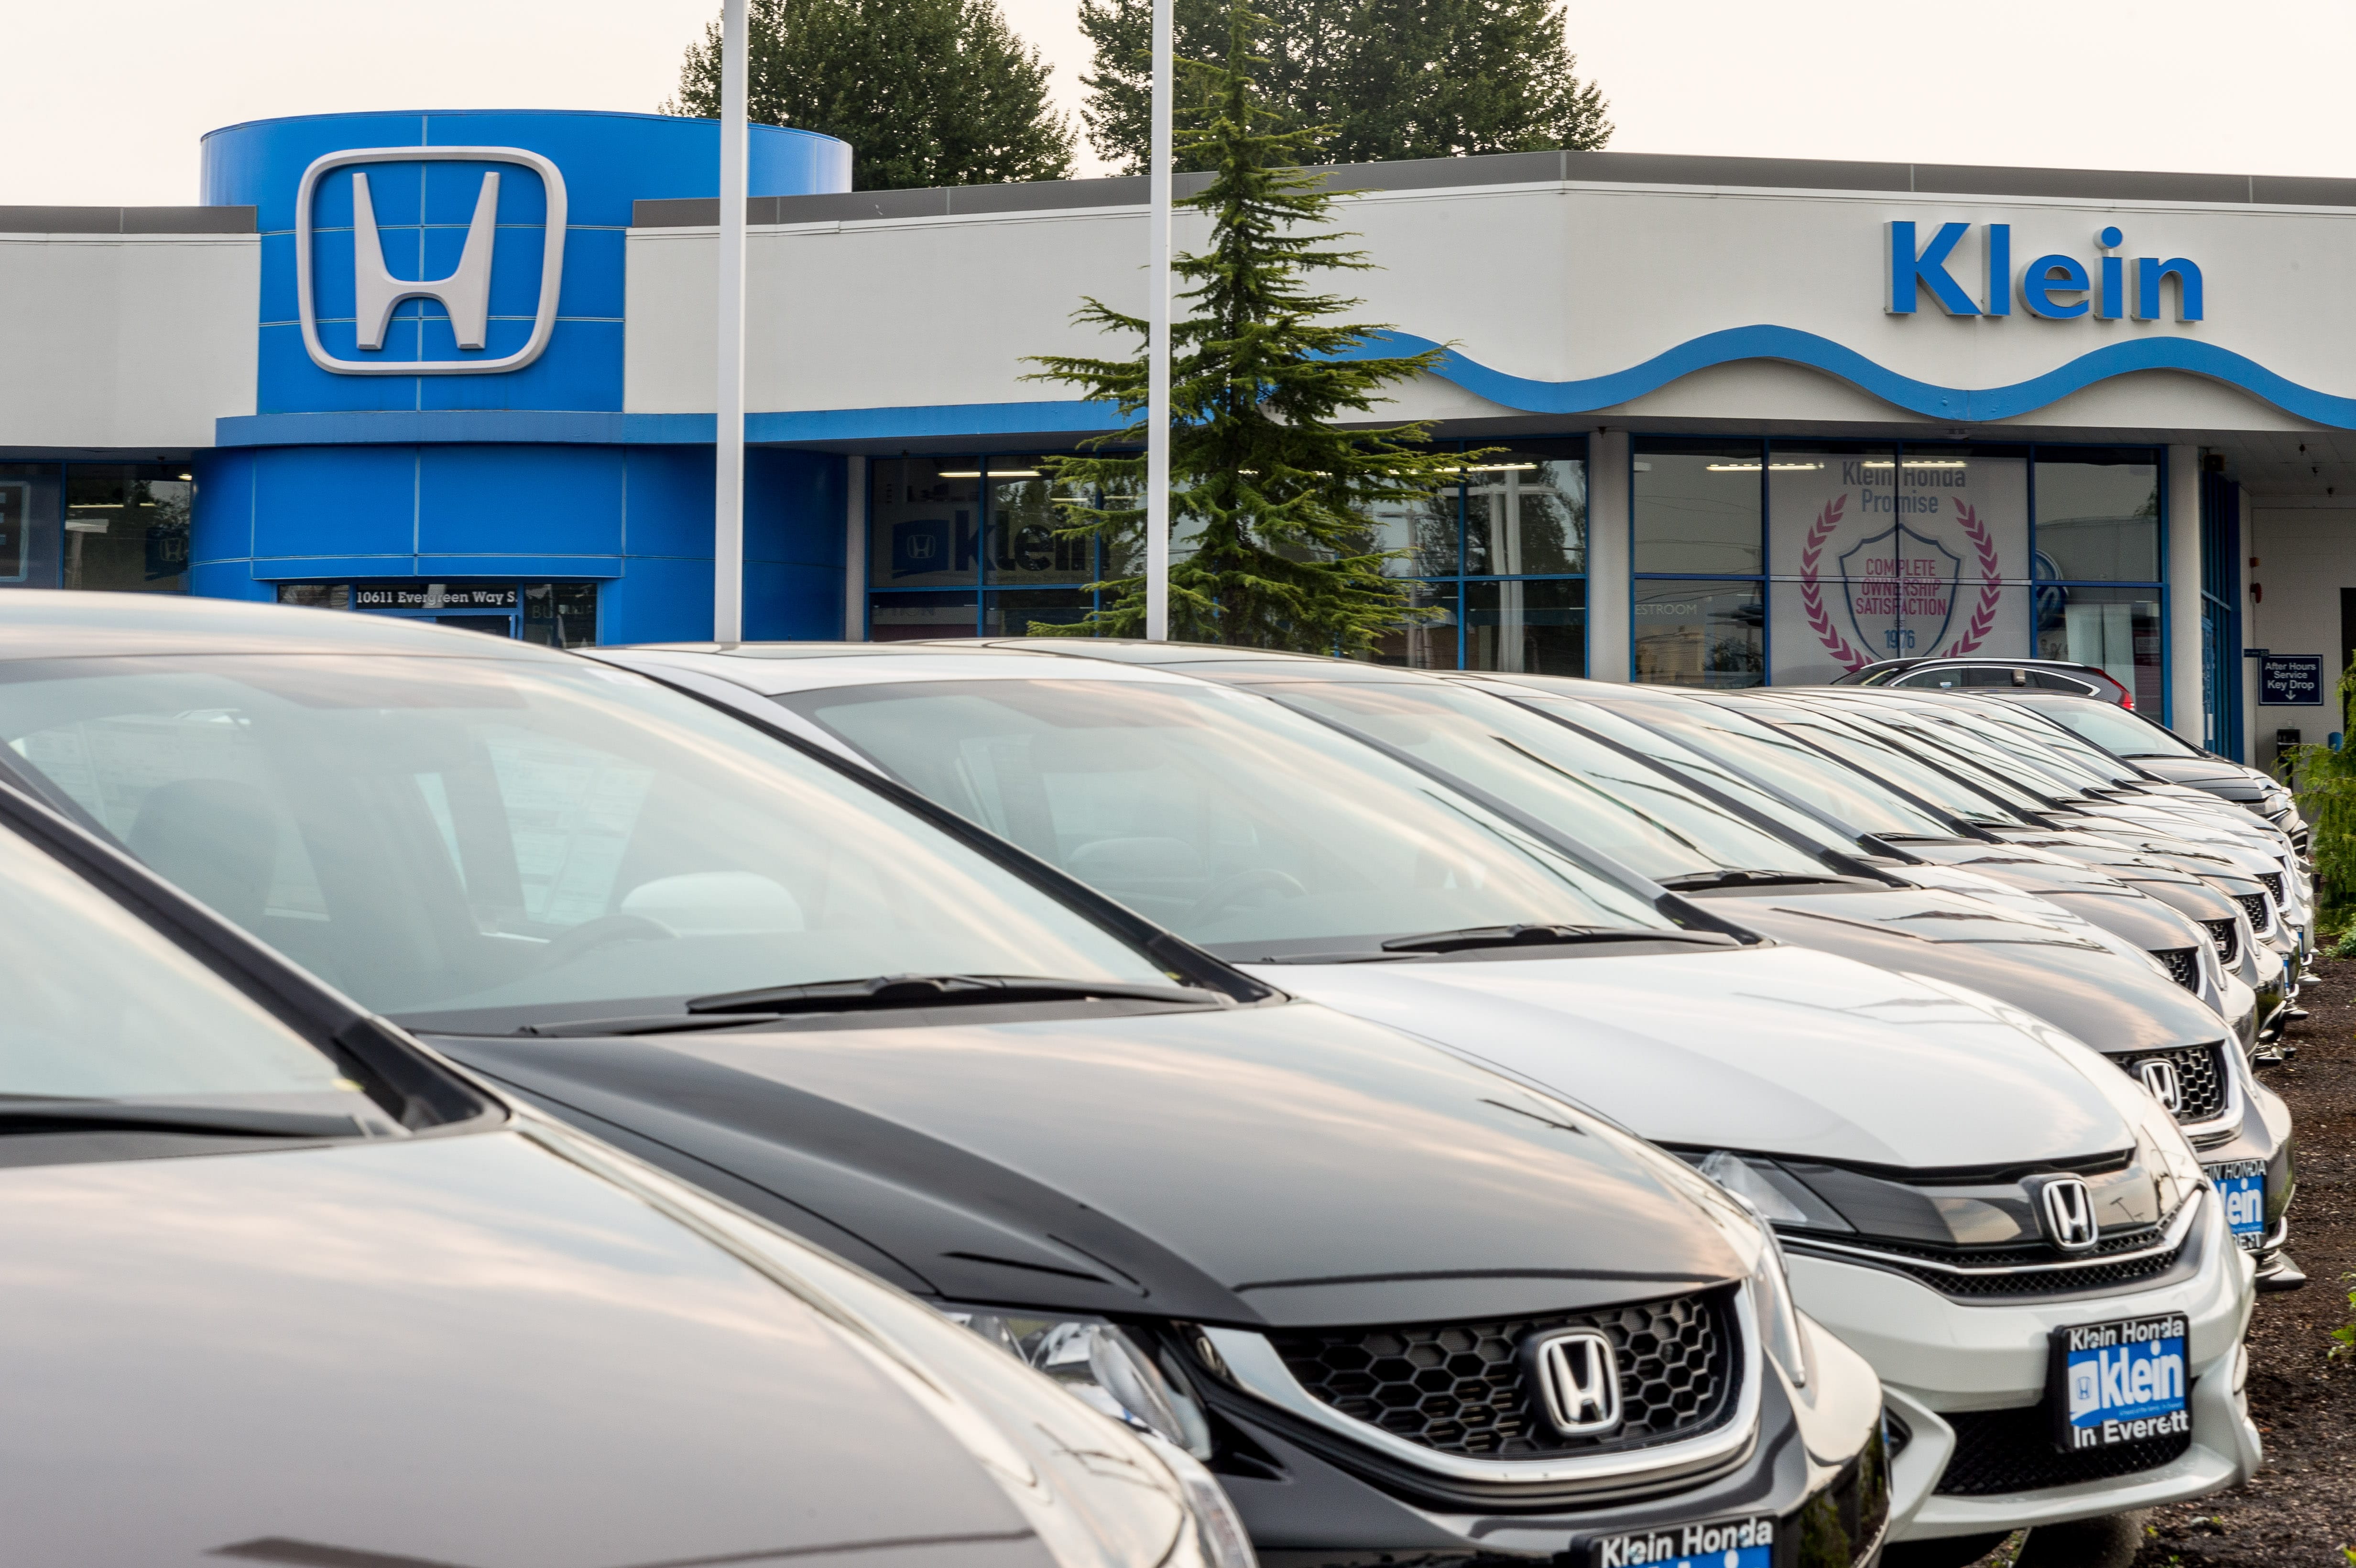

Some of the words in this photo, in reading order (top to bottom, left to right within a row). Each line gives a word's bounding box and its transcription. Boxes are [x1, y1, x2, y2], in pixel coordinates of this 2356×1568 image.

[1883, 220, 2203, 322] Klein
[1842, 460, 1892, 486] Klein
[1904, 462, 1966, 488] Honda
[1862, 488, 1939, 514] Promise
[1865, 558, 1936, 577] COMPLETE
[1861, 577, 1942, 596] OWNERSHIP
[357, 591, 393, 603] 10611
[397, 591, 469, 605] Evergreen
[471, 591, 504, 605] Way
[1855, 597, 1947, 616] SATISFACTION
[1635, 604, 1697, 615] ESTROOM
[1884, 629, 1915, 650] 1976
[2265, 662, 2287, 670] After
[2289, 662, 2316, 670] Hours
[2267, 680, 2287, 691] Key
[2289, 680, 2315, 691] Drop
[2224, 1159, 2267, 1180] HONDA
[2219, 1177, 2262, 1225] lein
[2070, 1326, 2116, 1352] Klein
[2121, 1316, 2185, 1344] Honda
[2098, 1339, 2184, 1409] klein
[2073, 1426, 2096, 1449] In
[2103, 1410, 2190, 1445] Everett
[1601, 1532, 1674, 1568] Klein
[1682, 1516, 1774, 1557] Honda
